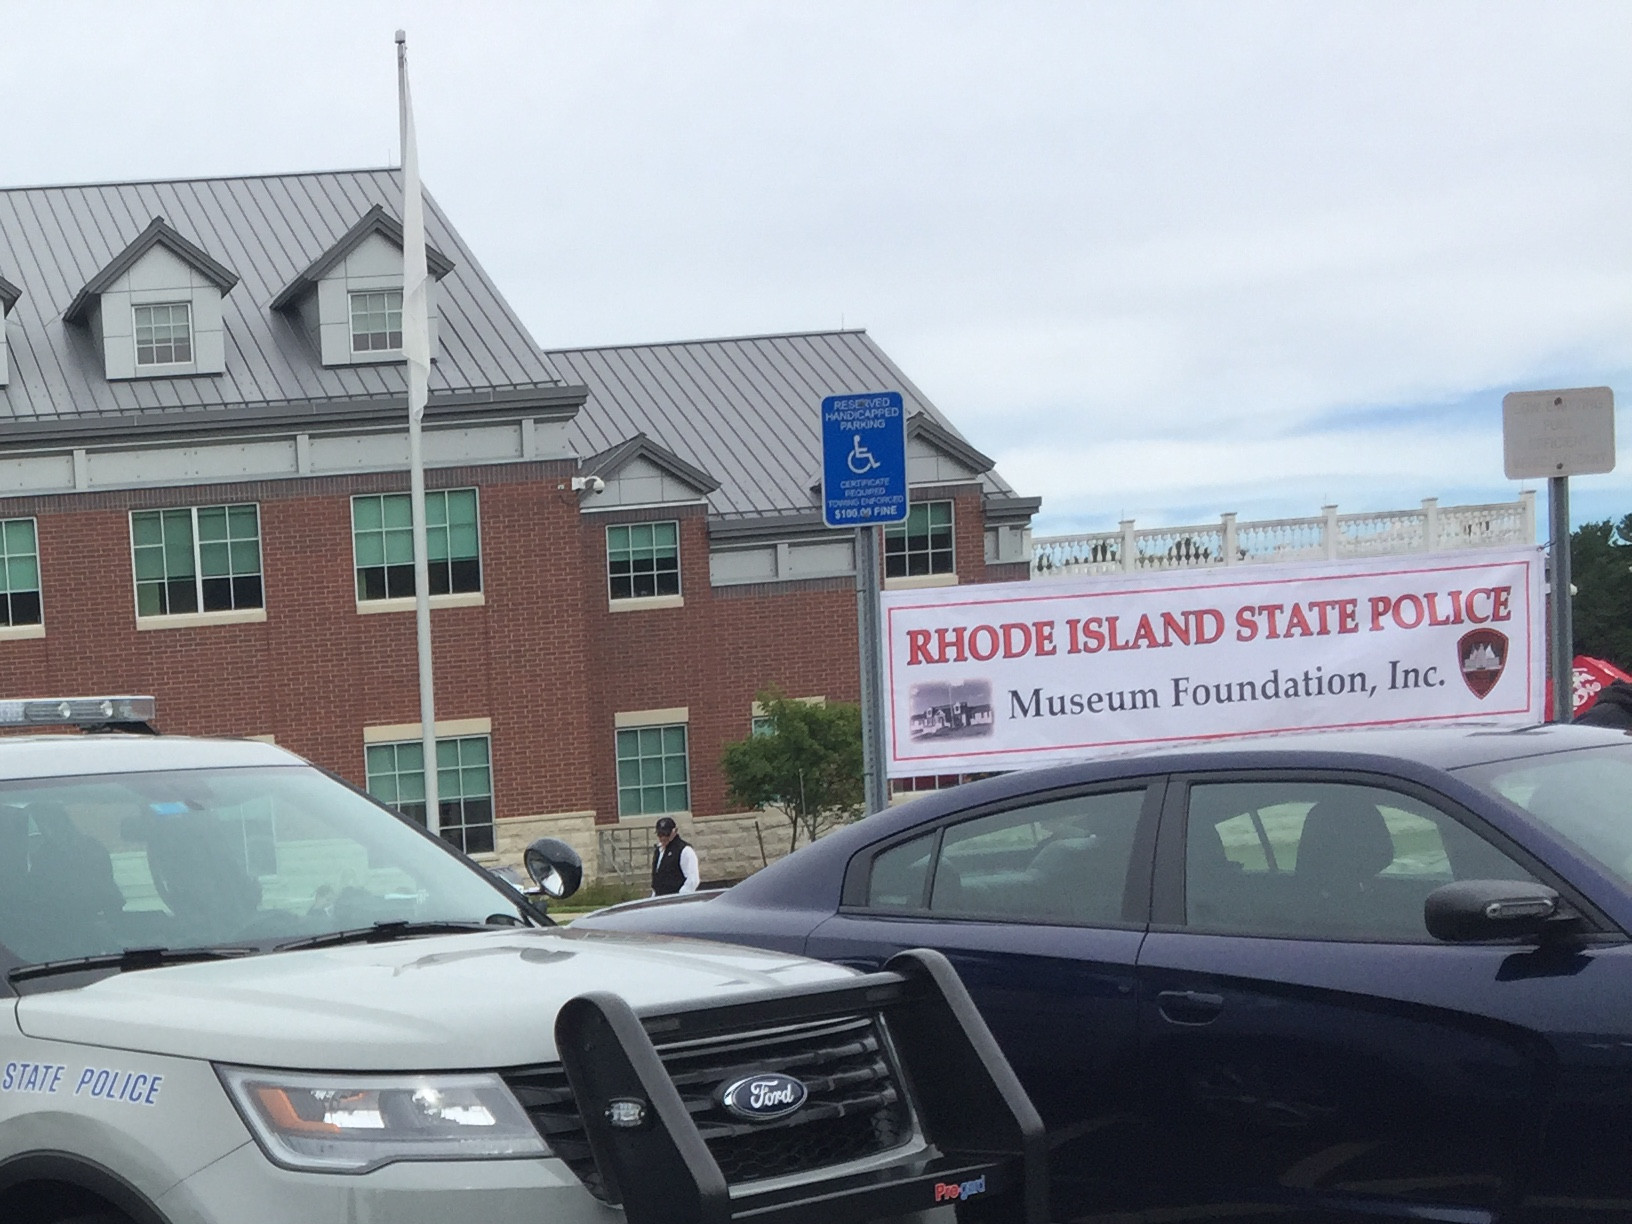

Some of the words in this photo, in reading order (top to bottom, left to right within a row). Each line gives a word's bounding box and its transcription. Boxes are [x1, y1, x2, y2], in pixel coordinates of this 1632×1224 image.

[825, 407, 900, 421] HANDICAPPED
[834, 398, 890, 410] RESERVED
[840, 419, 886, 430] PARKING
[874, 505, 897, 516] FINE
[905, 619, 1057, 666] RHODE
[1066, 606, 1225, 655] ISLAND
[1235, 598, 1359, 642] STATE
[1368, 586, 1512, 632] POLICE
[1008, 684, 1159, 719] Museum
[1171, 667, 1378, 704] Foundation,
[1387, 659, 1446, 690] Inc.
[2, 1062, 65, 1093] STATE
[75, 1068, 163, 1105] POLICE
[750, 1081, 794, 1109] Ford
